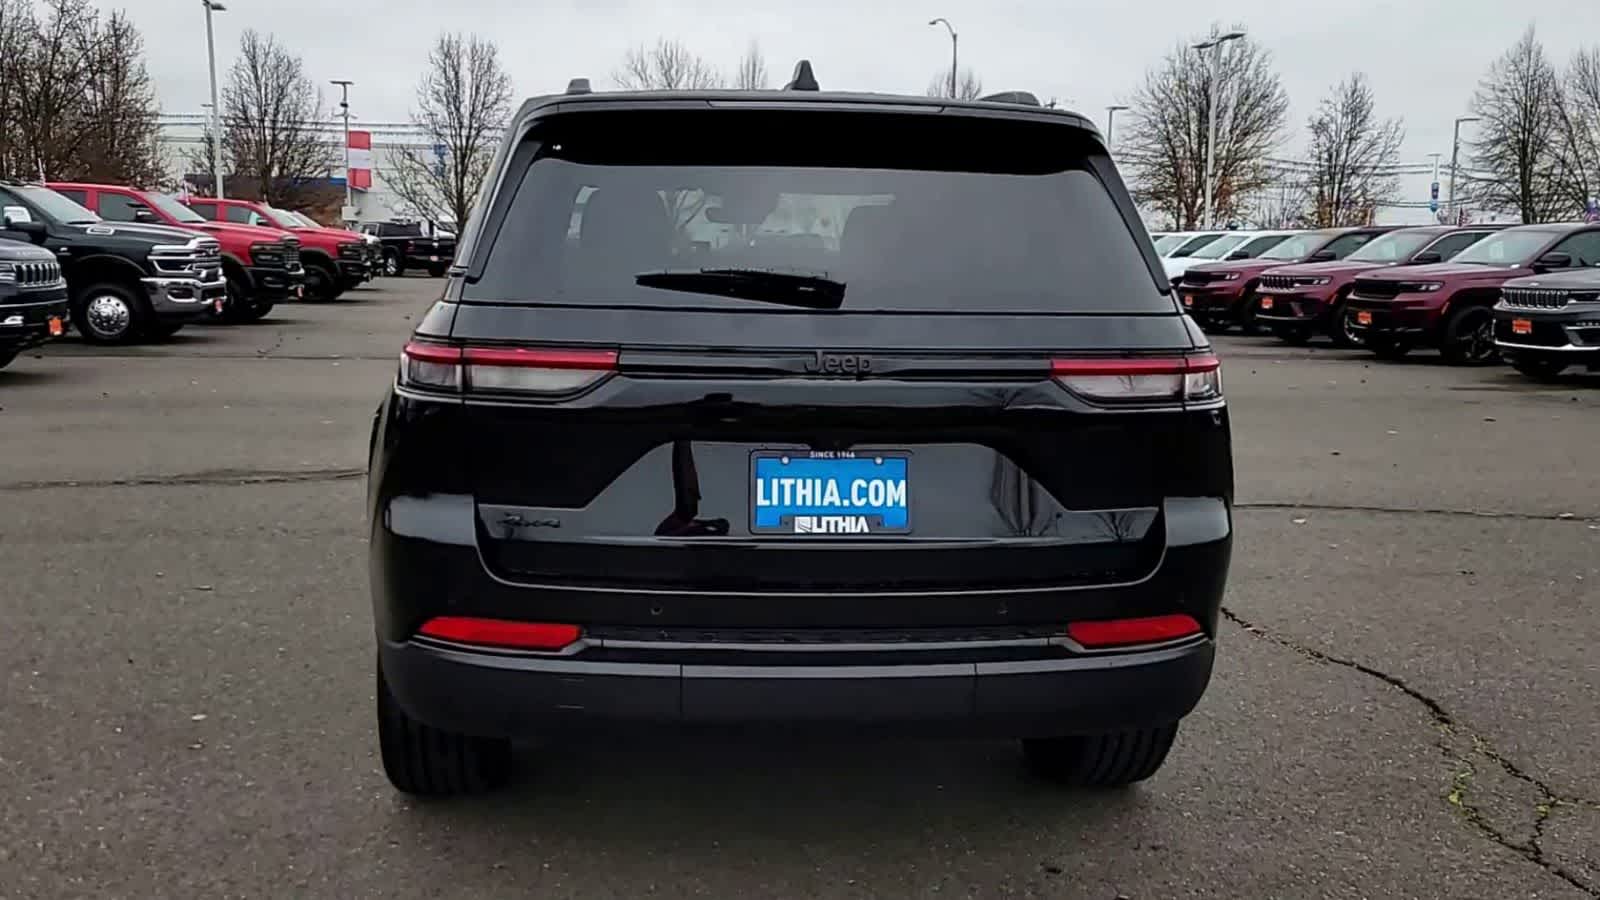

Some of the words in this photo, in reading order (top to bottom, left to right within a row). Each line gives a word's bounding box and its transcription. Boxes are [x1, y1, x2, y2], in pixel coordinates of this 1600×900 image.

[804, 350, 872, 380] Jeep
[810, 450, 835, 459] SINCE
[757, 478, 906, 507] LITHIA.COM
[812, 516, 869, 533] LITHIA
